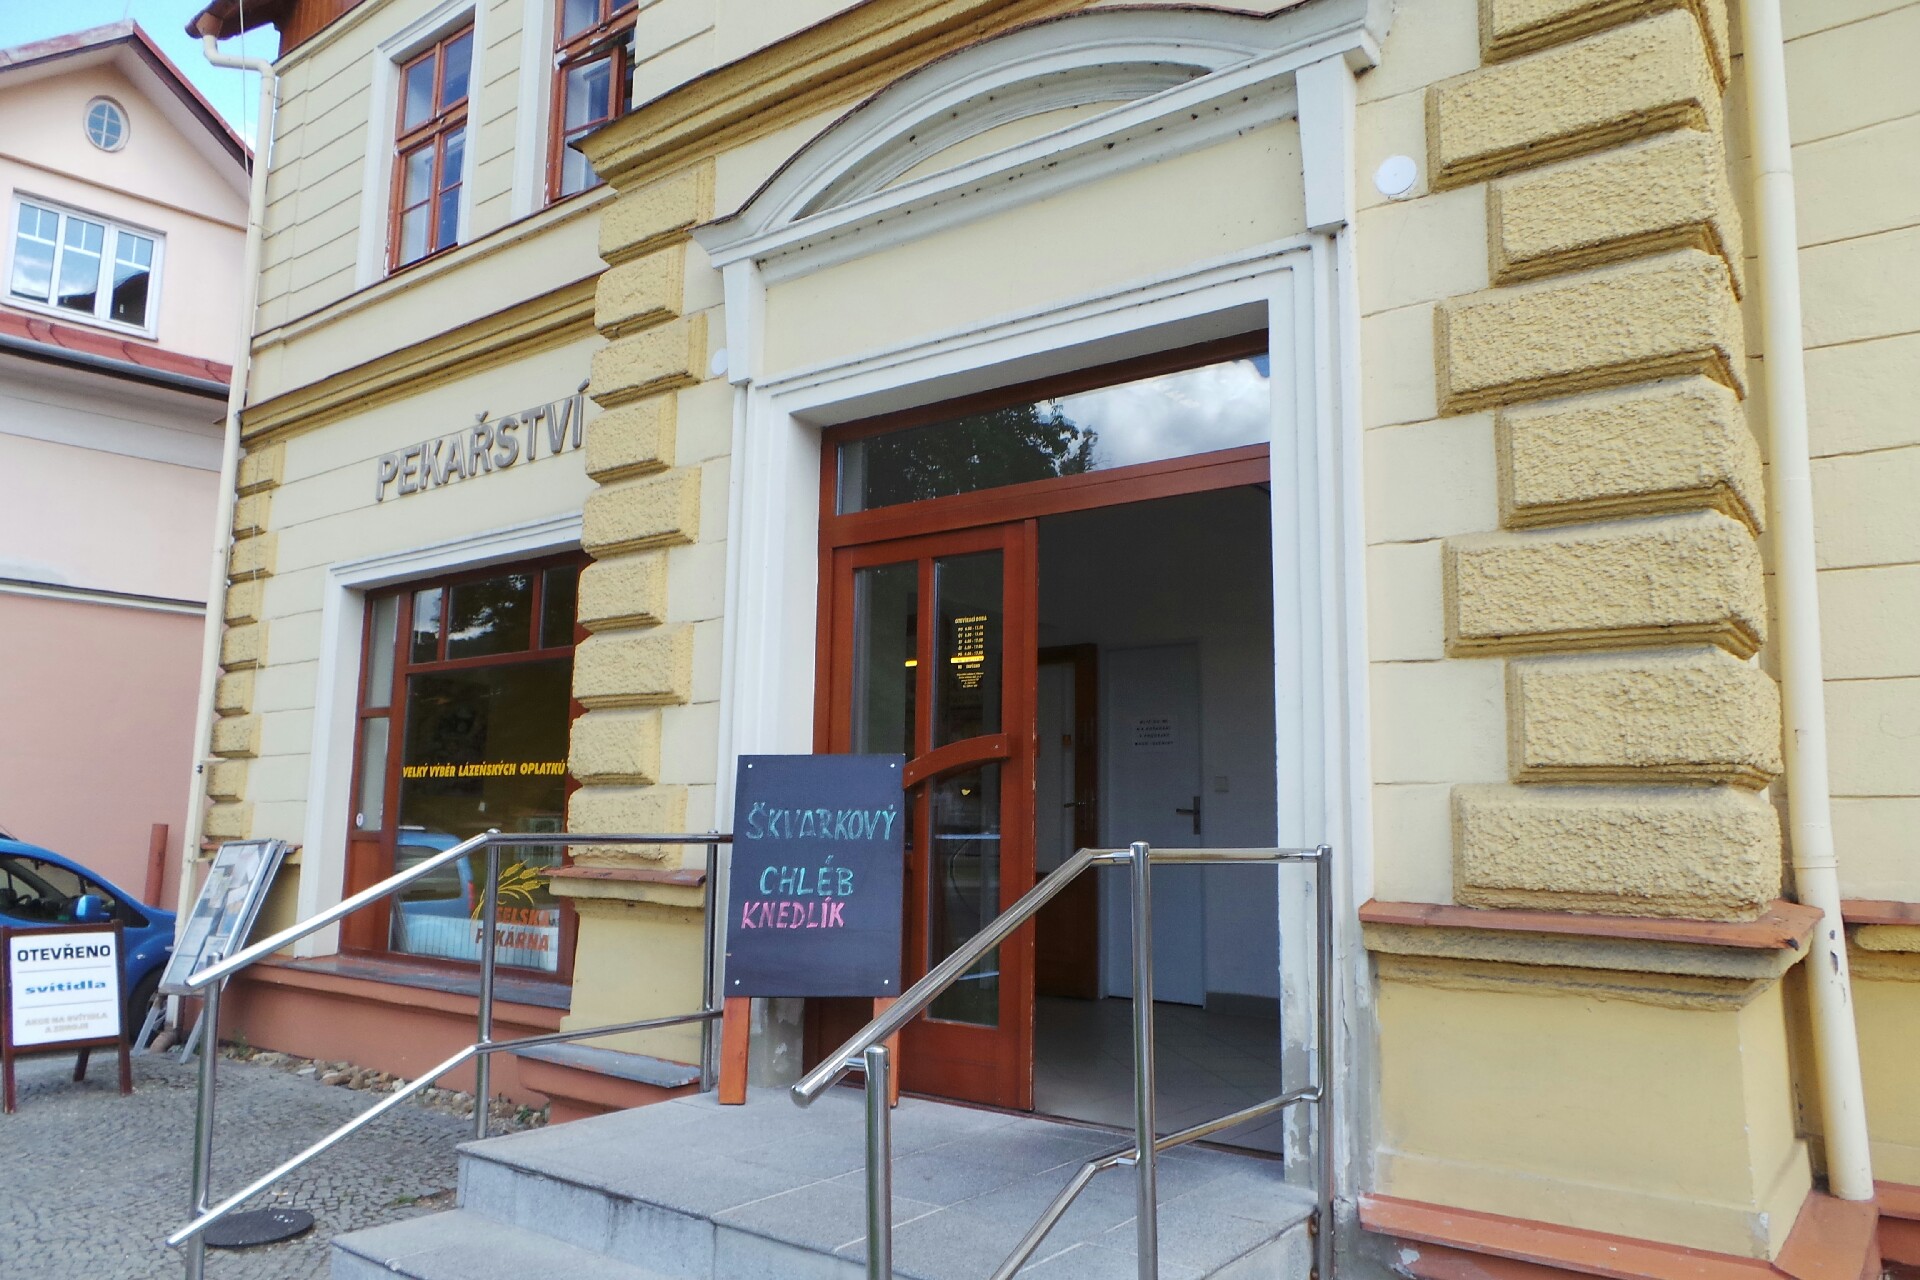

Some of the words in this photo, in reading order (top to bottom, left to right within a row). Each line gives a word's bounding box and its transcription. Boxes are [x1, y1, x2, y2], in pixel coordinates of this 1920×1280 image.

[375, 378, 590, 502] PEKAŘSTVÍ
[402, 763, 428, 778] VELKÝ
[745, 801, 897, 840] ŠKVARKOVÝ
[759, 855, 854, 896] CHLÉB
[741, 896, 846, 929] KNEDLÍK
[17, 943, 111, 962] OTEVŘENO
[475, 926, 549, 952] PKÁRNA
